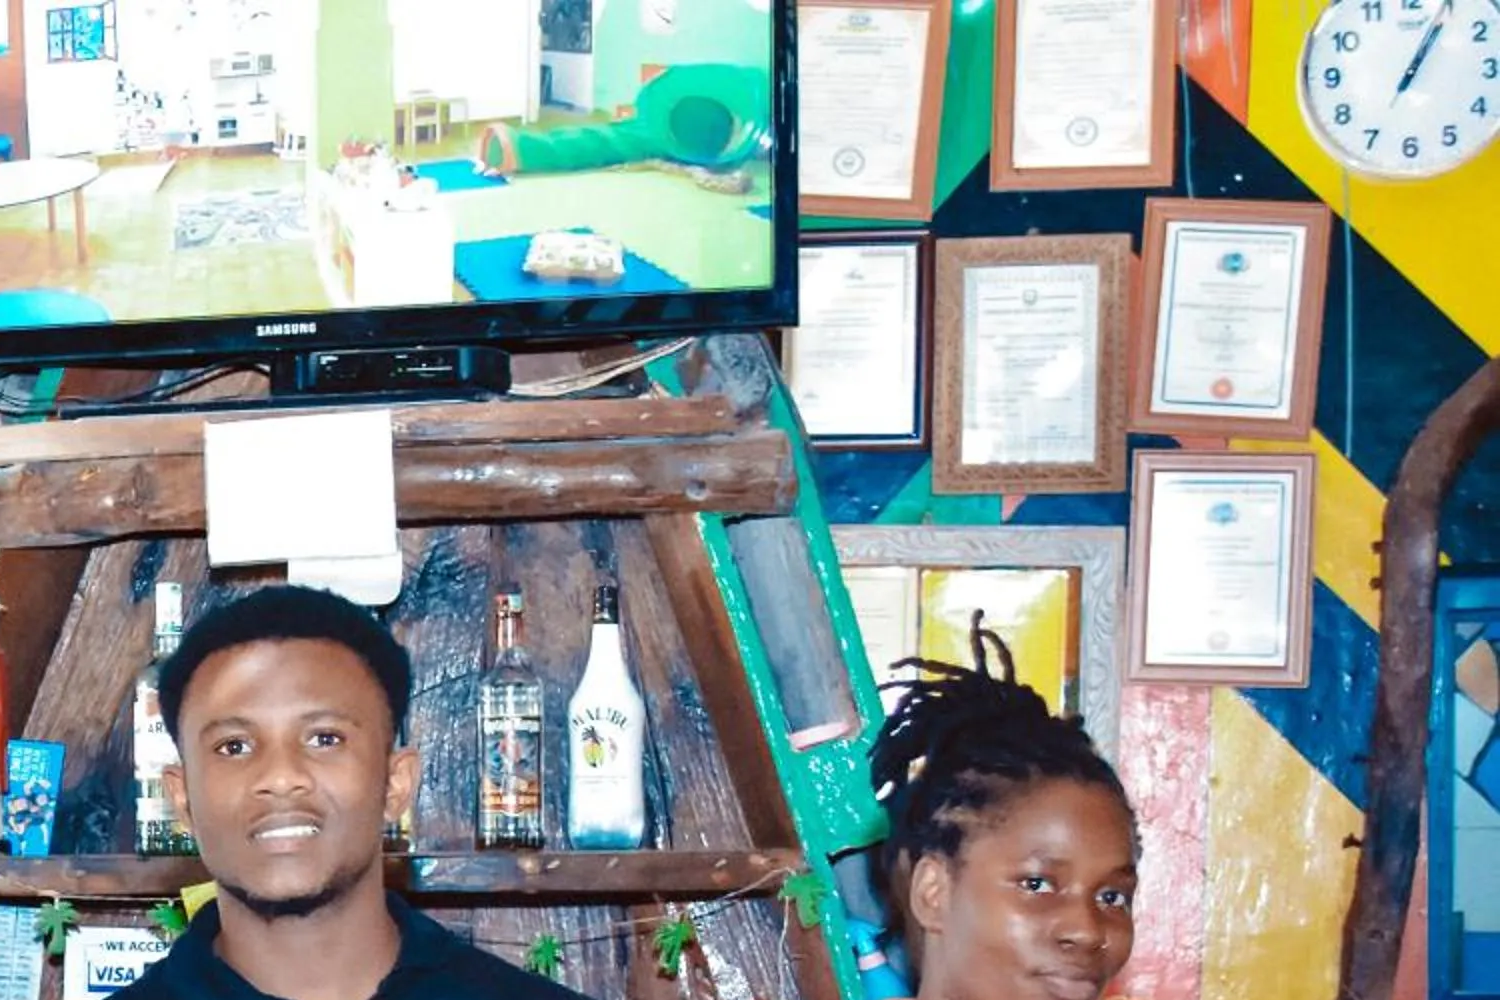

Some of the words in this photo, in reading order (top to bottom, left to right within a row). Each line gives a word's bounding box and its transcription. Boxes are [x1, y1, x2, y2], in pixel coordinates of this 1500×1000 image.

[1362, 1, 1382, 22] 11
[1332, 31, 1359, 52] 10
[1472, 21, 1488, 42] 2
[1324, 67, 1341, 89] 9
[1482, 58, 1498, 79] 3
[1335, 104, 1351, 125] 8
[1470, 96, 1487, 117] 4
[1364, 129, 1380, 151] 7
[1442, 125, 1457, 147] 5
[1403, 136, 1419, 158] 6
[256, 322, 317, 337] SAMSUNG
[105, 941, 125, 951] WE
[129, 940, 171, 952] ACCEP
[95, 966, 136, 983] VISA
